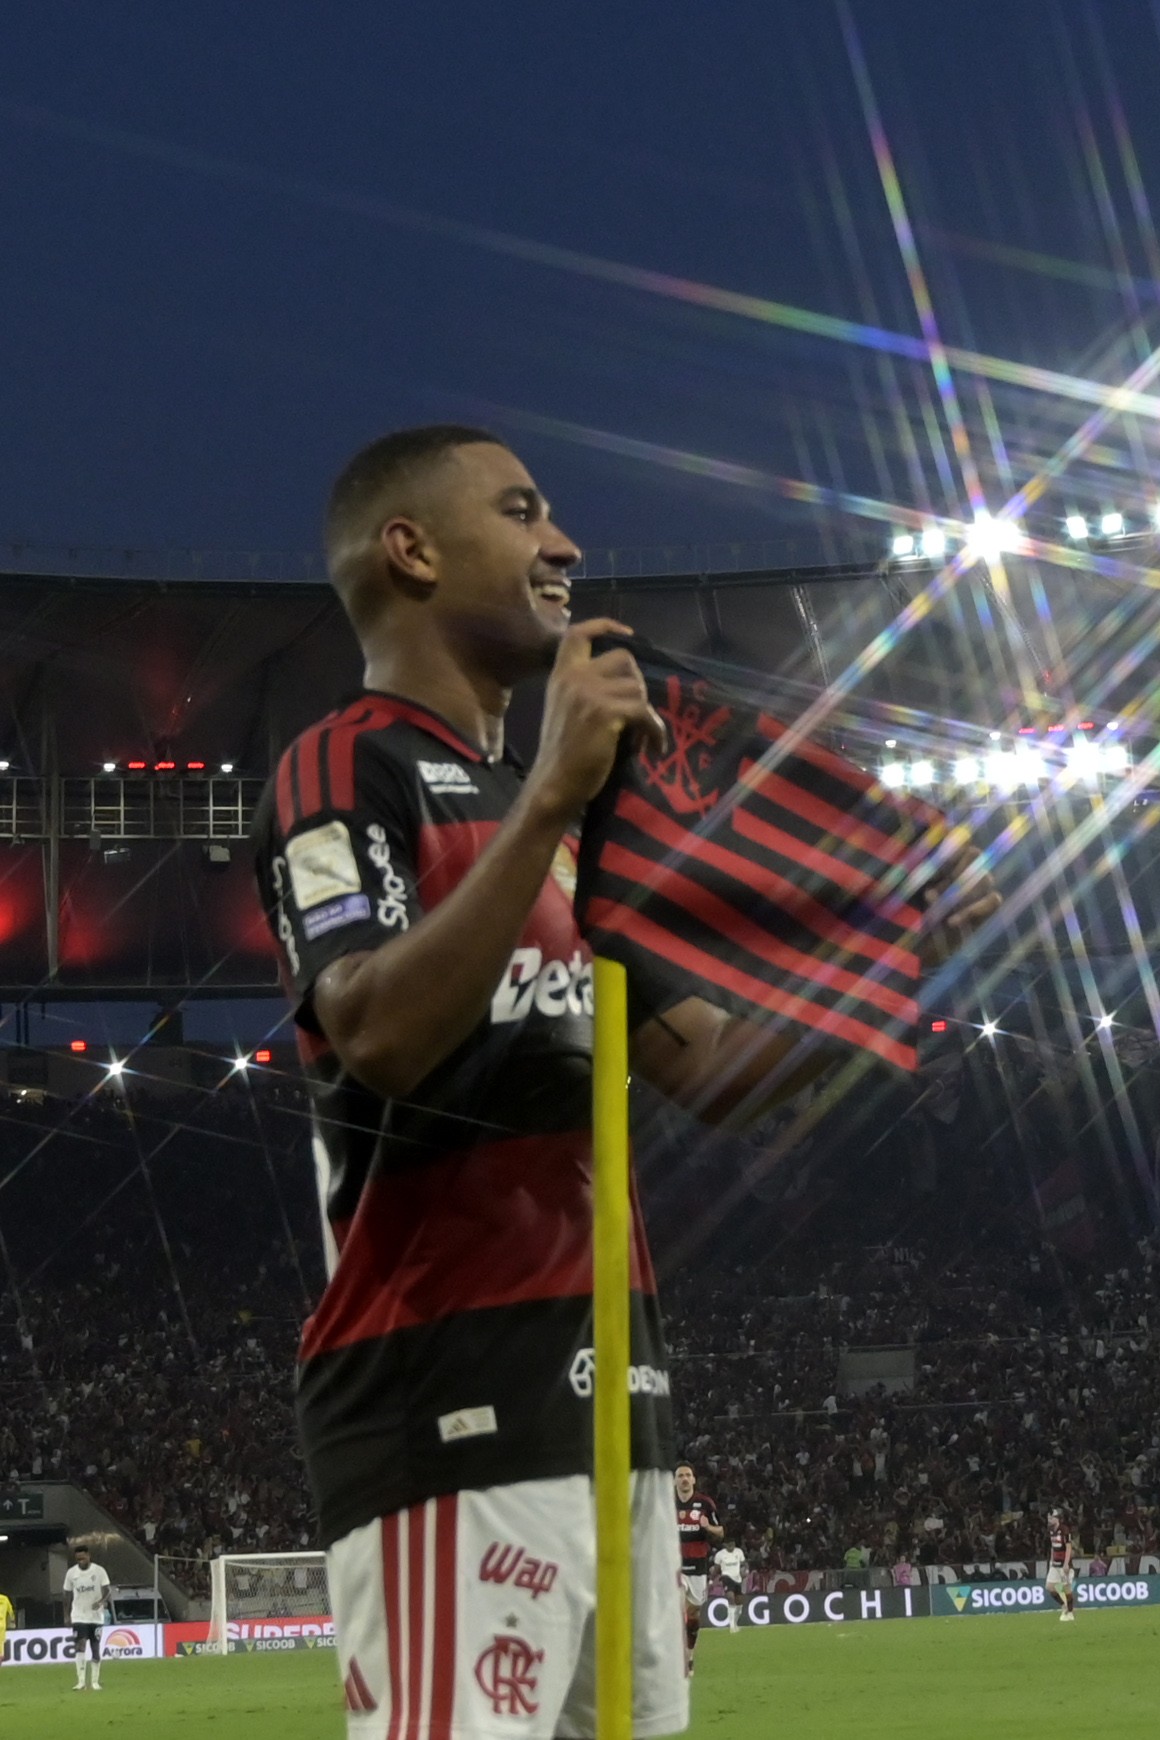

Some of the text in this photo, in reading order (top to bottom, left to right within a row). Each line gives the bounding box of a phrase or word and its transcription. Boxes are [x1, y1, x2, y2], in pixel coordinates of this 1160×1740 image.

[366, 822, 410, 933] Shopee
[479, 1541, 558, 1600] Wap
[971, 1585, 1045, 1608] SICOOB
[1076, 1581, 1149, 1603] SICOOB
[195, 1641, 236, 1654] SICOB
[256, 1638, 296, 1651] SICOOB
